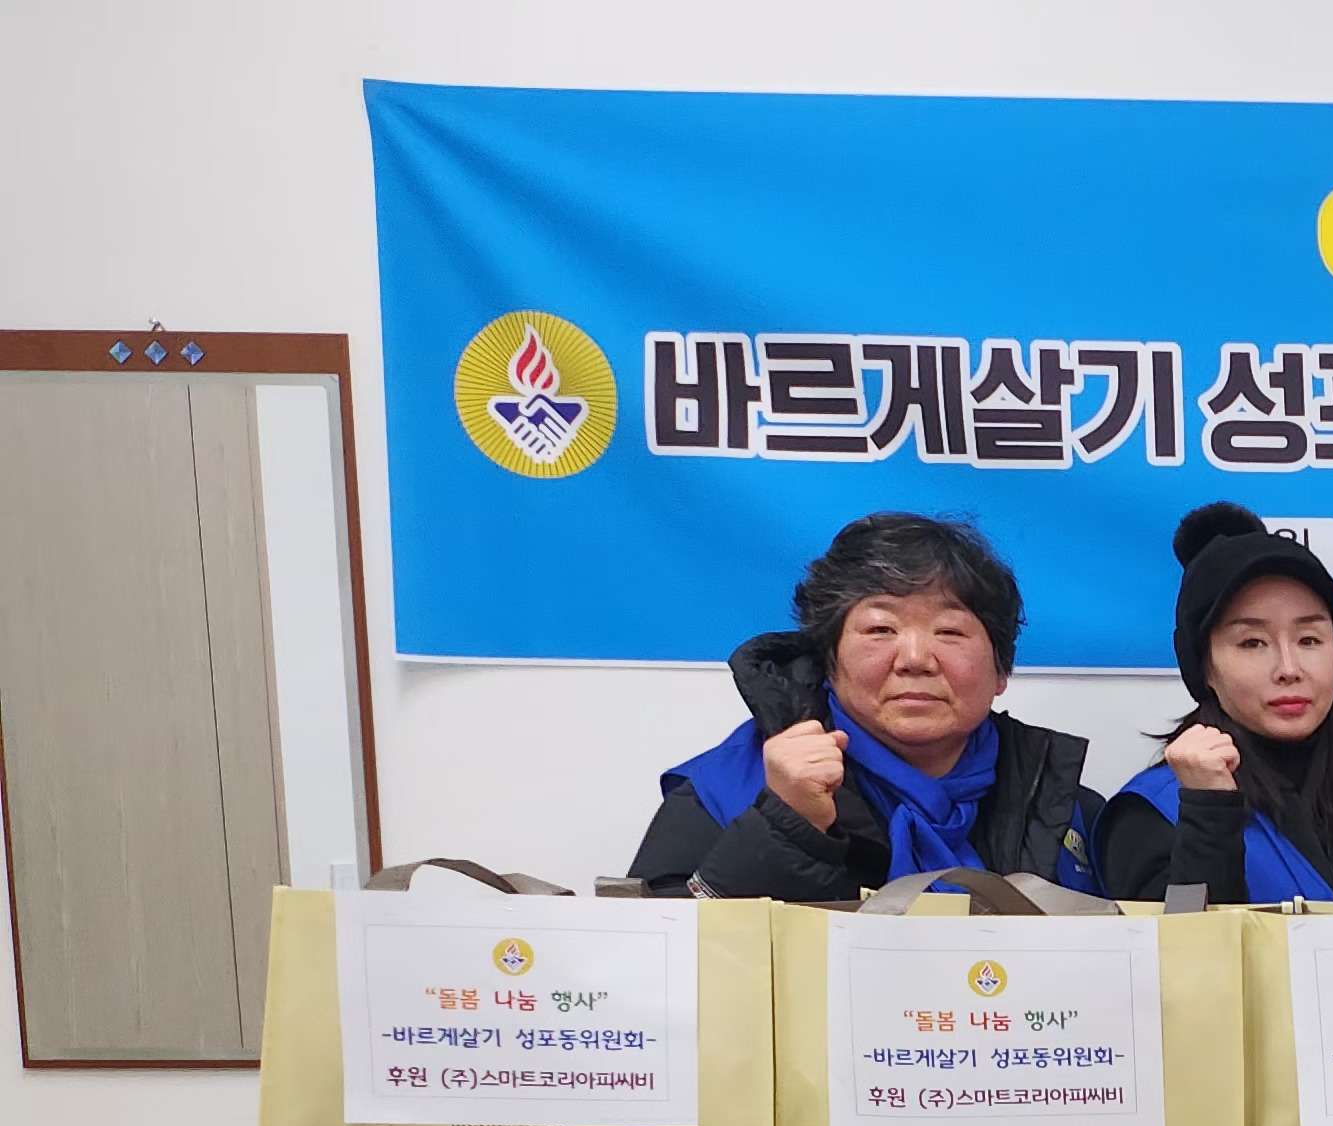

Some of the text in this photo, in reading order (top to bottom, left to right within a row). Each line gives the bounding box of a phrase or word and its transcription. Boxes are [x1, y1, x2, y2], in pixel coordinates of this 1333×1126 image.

[648, 336, 1180, 464] 바르게살기
[494, 989, 538, 1012] 나눔
[969, 1011, 1012, 1032] 나눔
[386, 1065, 654, 1091] 후원 (주)스마트코리아피씨비
[867, 1086, 1124, 1110] 후원 (주)스마트코리아피씨비
